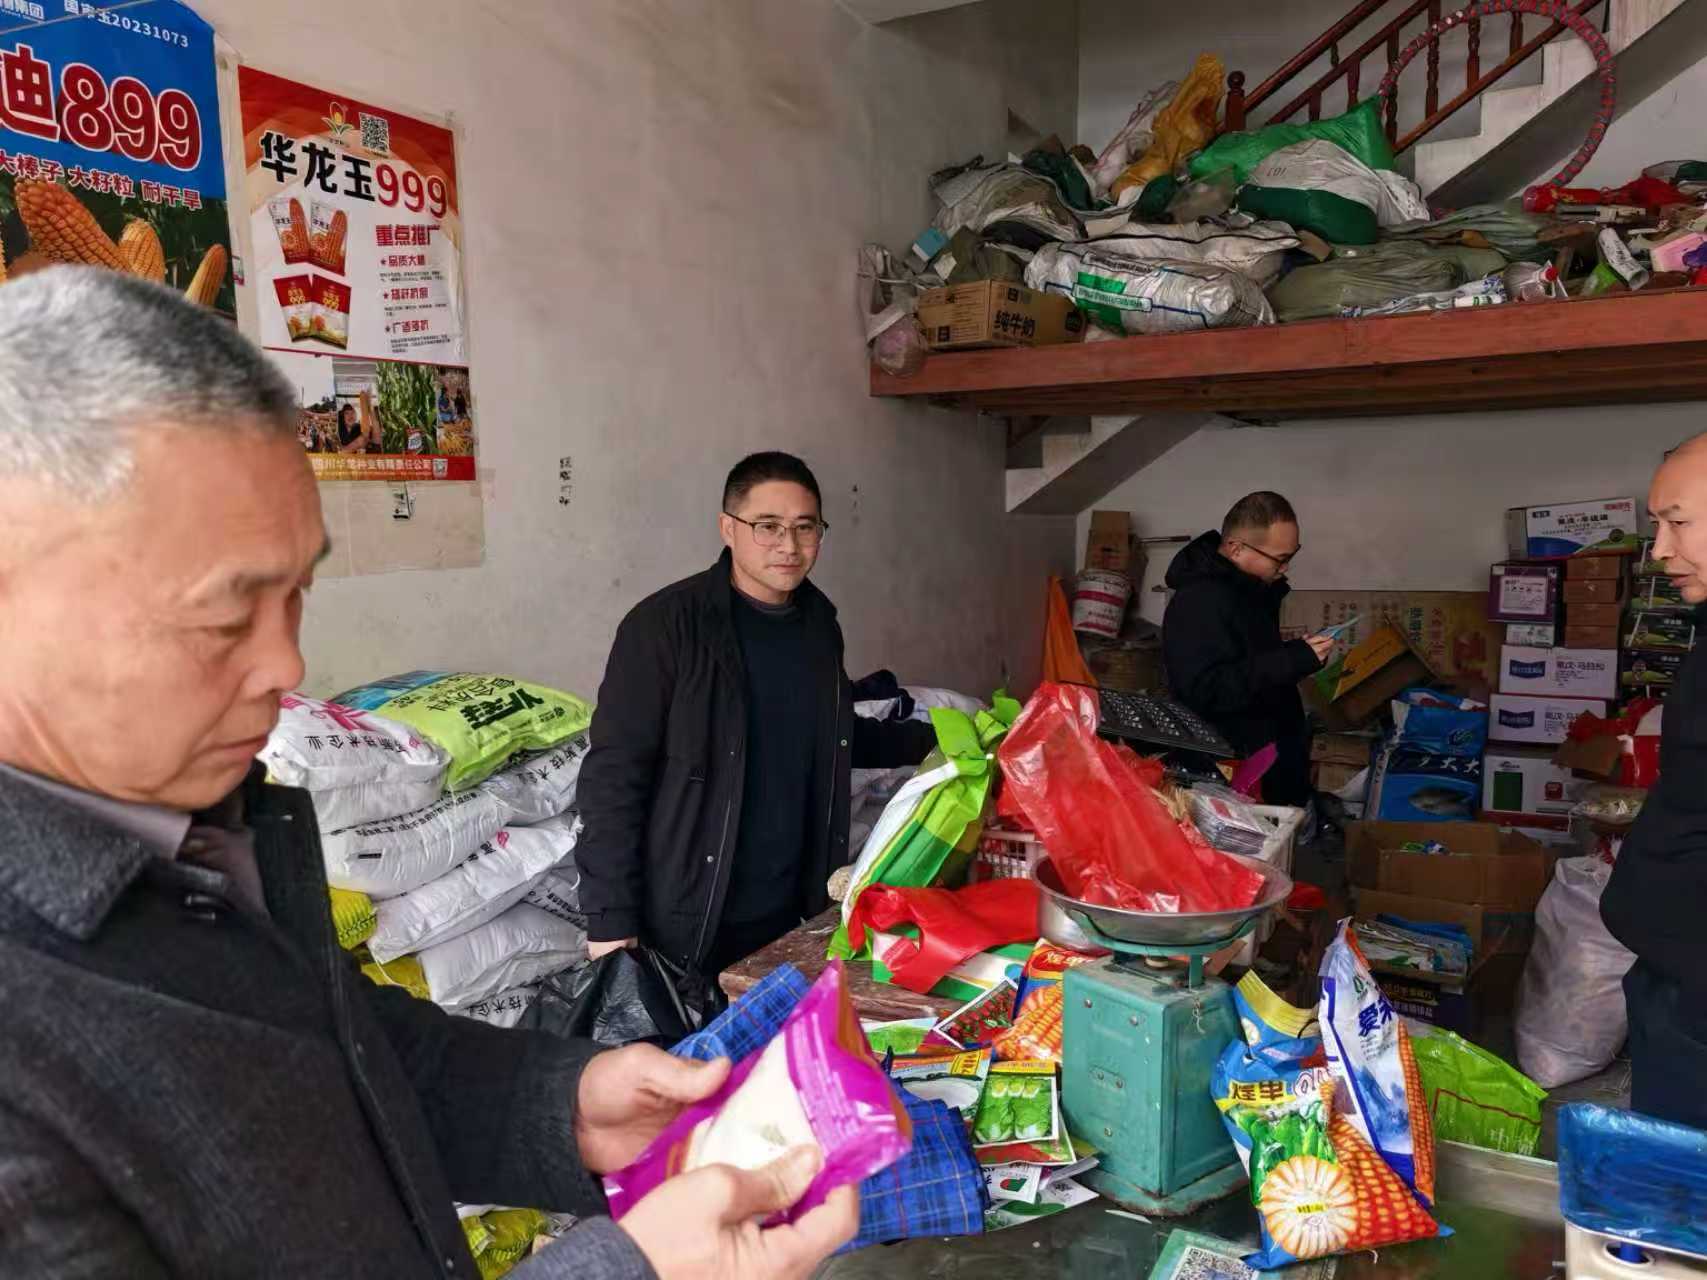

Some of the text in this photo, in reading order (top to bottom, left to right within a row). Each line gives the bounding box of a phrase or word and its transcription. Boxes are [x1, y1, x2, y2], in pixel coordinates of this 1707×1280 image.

[68, 165, 136, 198] 大籽粒
[141, 179, 202, 211] 耐干旱
[260, 131, 449, 219] 华龙玉999
[376, 224, 441, 246] 重点推广
[994, 309, 1037, 337] 纯牛奶
